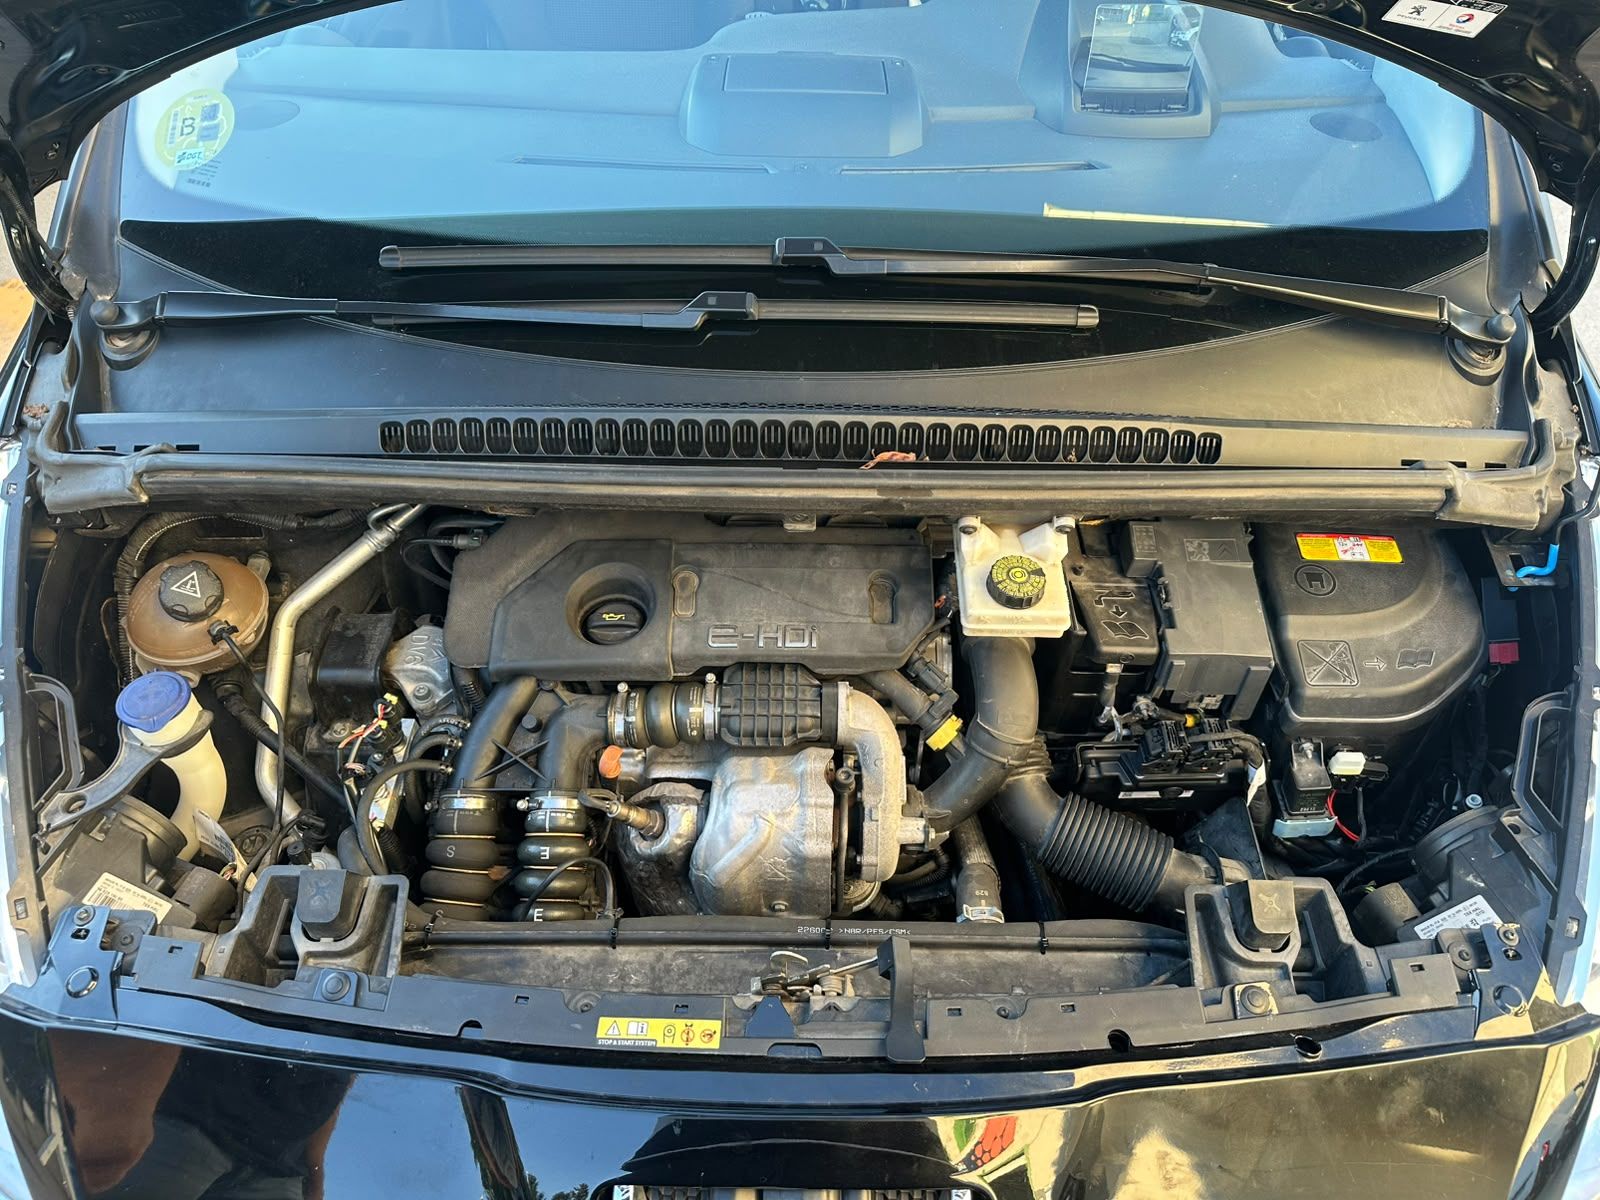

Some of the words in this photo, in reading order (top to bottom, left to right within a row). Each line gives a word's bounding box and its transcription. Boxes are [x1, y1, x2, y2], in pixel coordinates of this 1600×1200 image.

[180, 117, 196, 137] B
[446, 845, 456, 858] S
[540, 847, 550, 860] E
[533, 909, 544, 922] E
